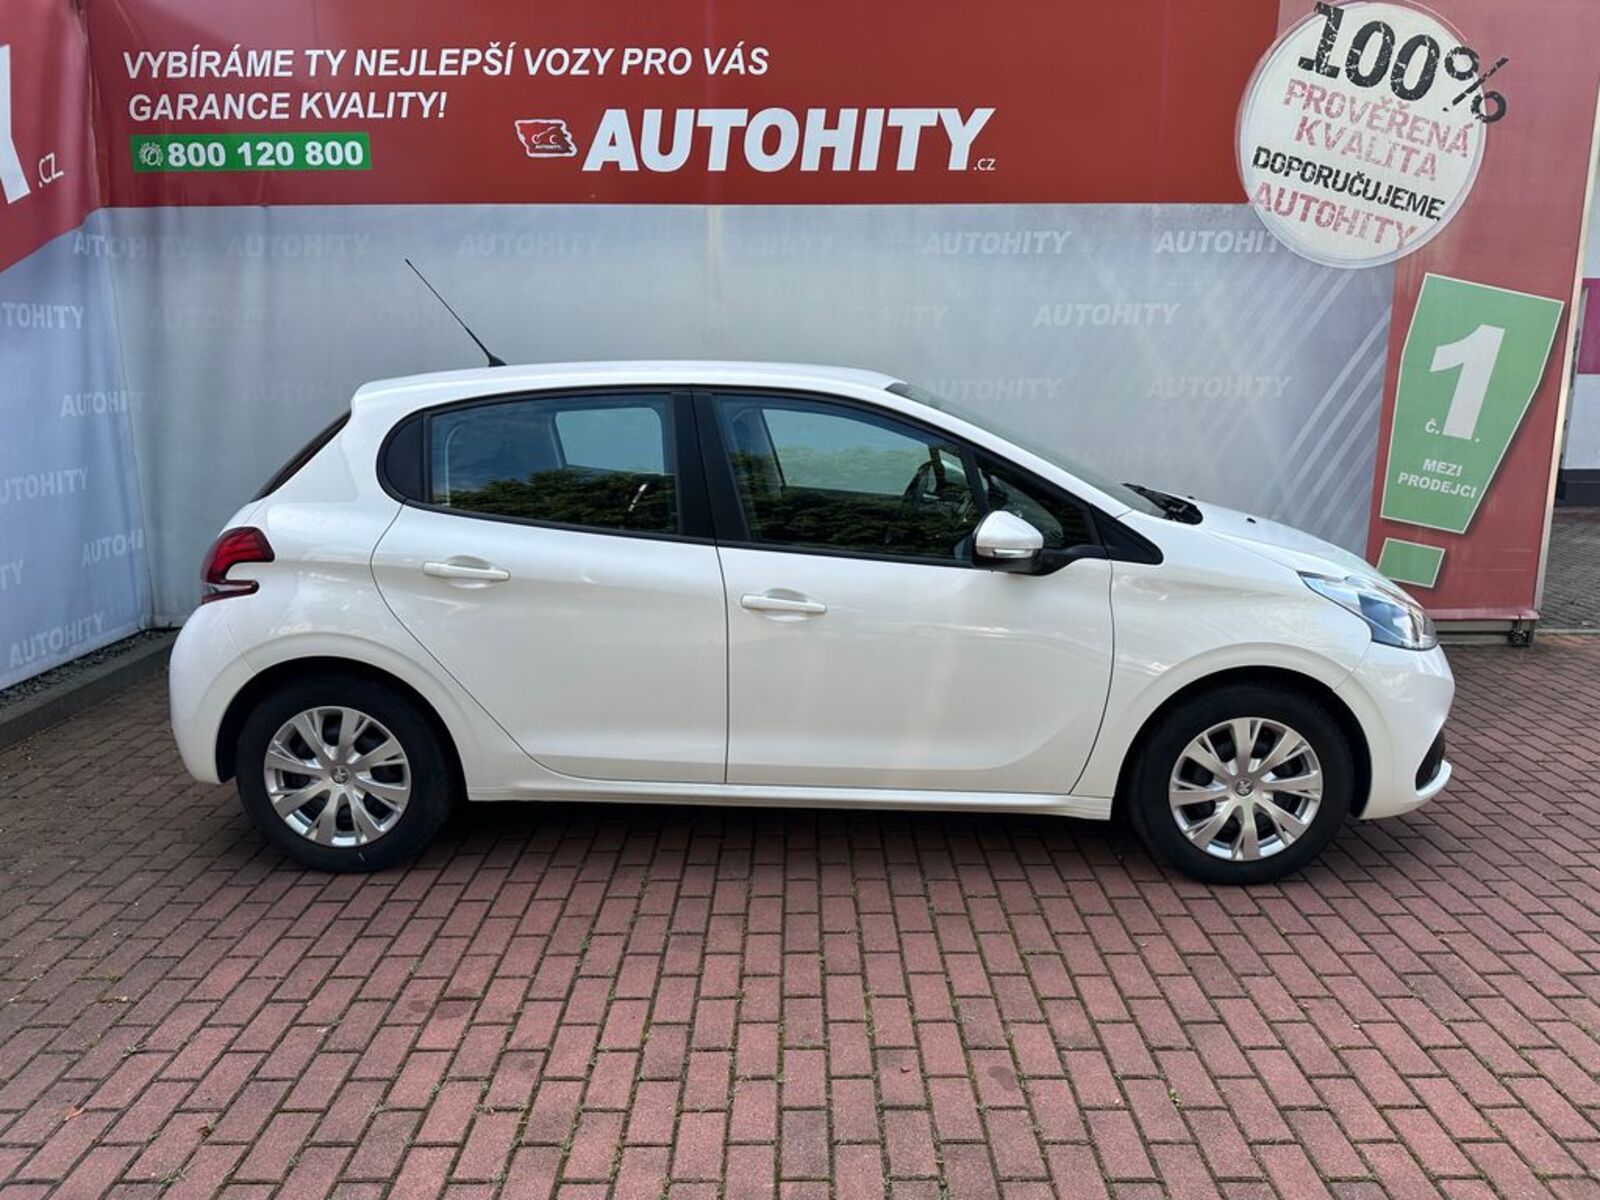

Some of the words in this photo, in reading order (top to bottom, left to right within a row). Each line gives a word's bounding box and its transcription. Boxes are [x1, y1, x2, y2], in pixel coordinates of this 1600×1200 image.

[122, 44, 295, 79] VYBÍRÁME
[304, 48, 347, 76] TY
[353, 41, 517, 77] NEJLEPŠÍ
[523, 47, 615, 76] VOZY
[620, 47, 693, 76] PRO
[703, 41, 770, 76] VÁS
[1296, 0, 1510, 124] 100%
[128, 92, 291, 121] GARANCE
[299, 91, 448, 119] KVALITY!
[1283, 78, 1474, 158] PROVĚŘENÁ
[167, 142, 226, 167] 800
[237, 141, 295, 167] 120
[304, 141, 364, 166] 800
[581, 107, 996, 173] AUTOHITY
[1294, 115, 1438, 182] KVALITA
[1252, 146, 1447, 222] DOPORUČUJEME
[1254, 181, 1418, 252] AUTOHITY
[922, 231, 1072, 255] AUTOHITY
[1034, 303, 1181, 327] AUTOHITY
[1147, 376, 1293, 399] AUTOHITY
[1397, 471, 1477, 499] PRODEJCI
[1422, 458, 1463, 478] MEZI
